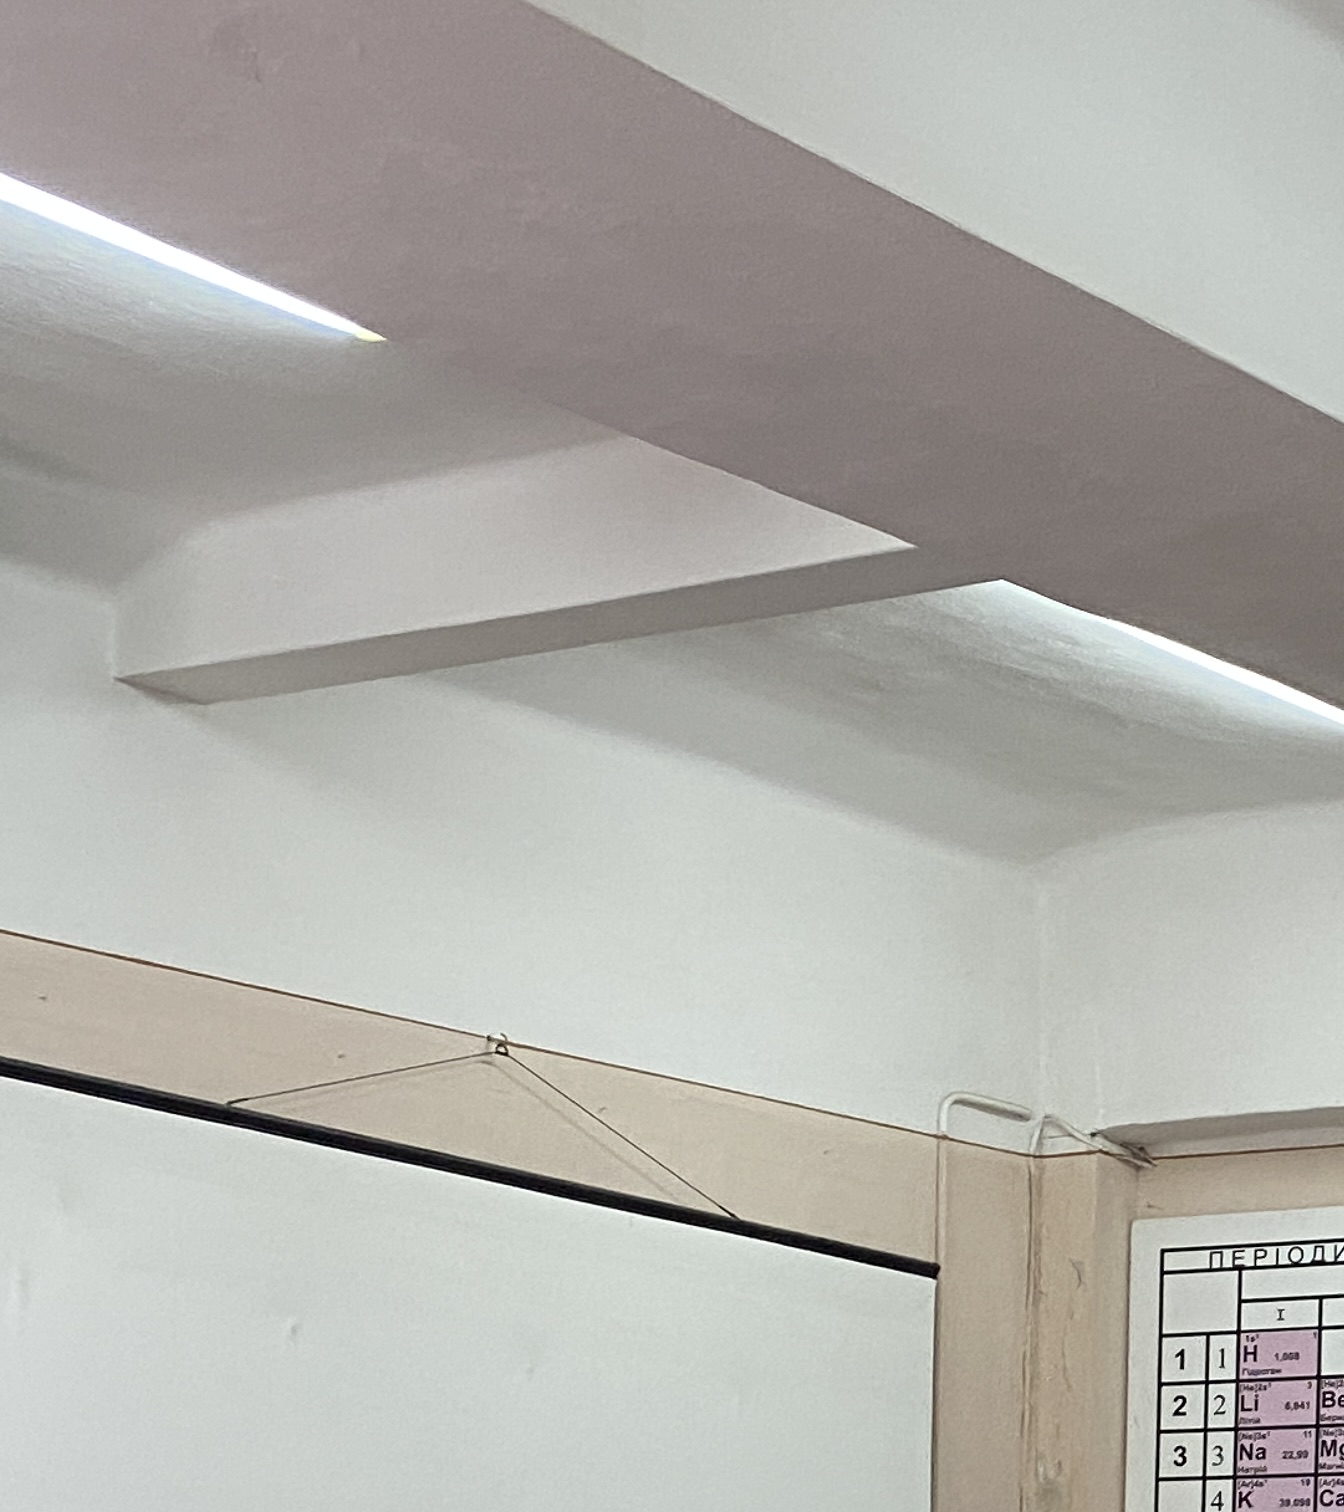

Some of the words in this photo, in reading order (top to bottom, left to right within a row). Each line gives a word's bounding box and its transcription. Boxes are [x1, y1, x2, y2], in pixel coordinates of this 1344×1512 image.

[1277, 1308, 1285, 1321] I
[1175, 1348, 1185, 1370] 1
[1219, 1348, 1225, 1369] 1
[1243, 1344, 1258, 1363] H
[1172, 1395, 1187, 1417] 2
[1213, 1394, 1226, 1416] 2
[1240, 1394, 1259, 1412] Li
[1173, 1445, 1187, 1467] 3
[1212, 1445, 1224, 1466] 3
[1239, 1443, 1267, 1461] Na
[1210, 1491, 1224, 1512] 4
[1238, 1491, 1253, 1509] K
